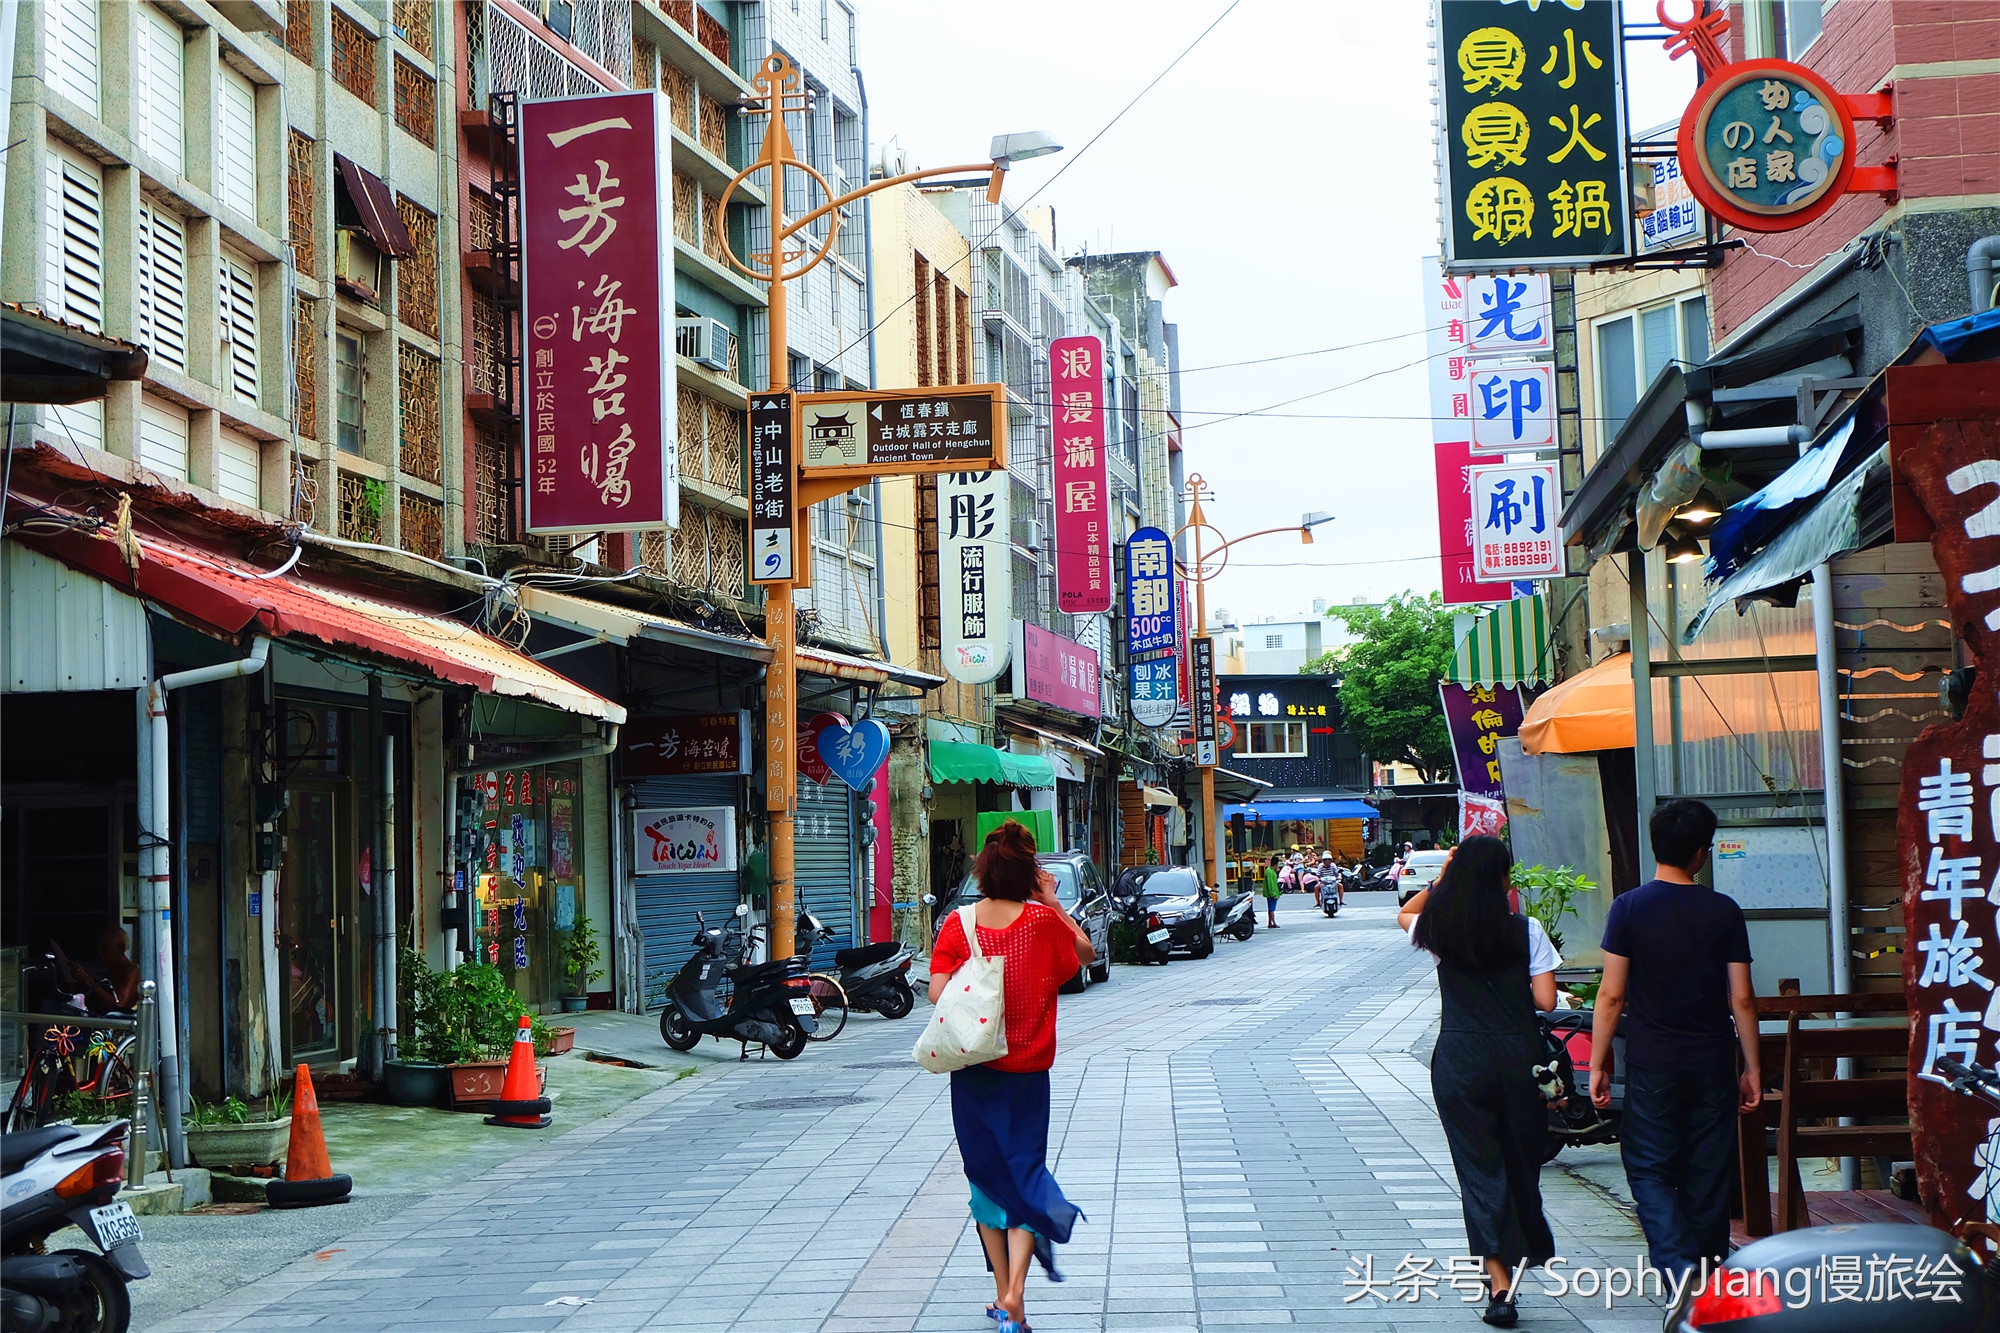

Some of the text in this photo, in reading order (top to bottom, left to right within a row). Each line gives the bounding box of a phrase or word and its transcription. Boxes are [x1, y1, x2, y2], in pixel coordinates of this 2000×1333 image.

[1541, 28, 1612, 239] 小火鍋
[535, 348, 557, 495] 創立於民國52年
[872, 438, 991, 453] Outdoor Hall of Hengchun
[879, 419, 978, 440] 古城露天走廊
[900, 401, 950, 419] 恆春鎮
[1060, 347, 1096, 514] 浪漫滿屋
[753, 425, 764, 518] Jhongshan Old St.
[764, 419, 785, 519] 中山老街
[872, 452, 934, 463] Ancient Town
[963, 547, 984, 638] 流行服飾
[1129, 538, 1169, 617] 南都
[1131, 633, 1173, 651] 木瓜牛奶
[1918, 757, 1995, 1076] 青年旅店
